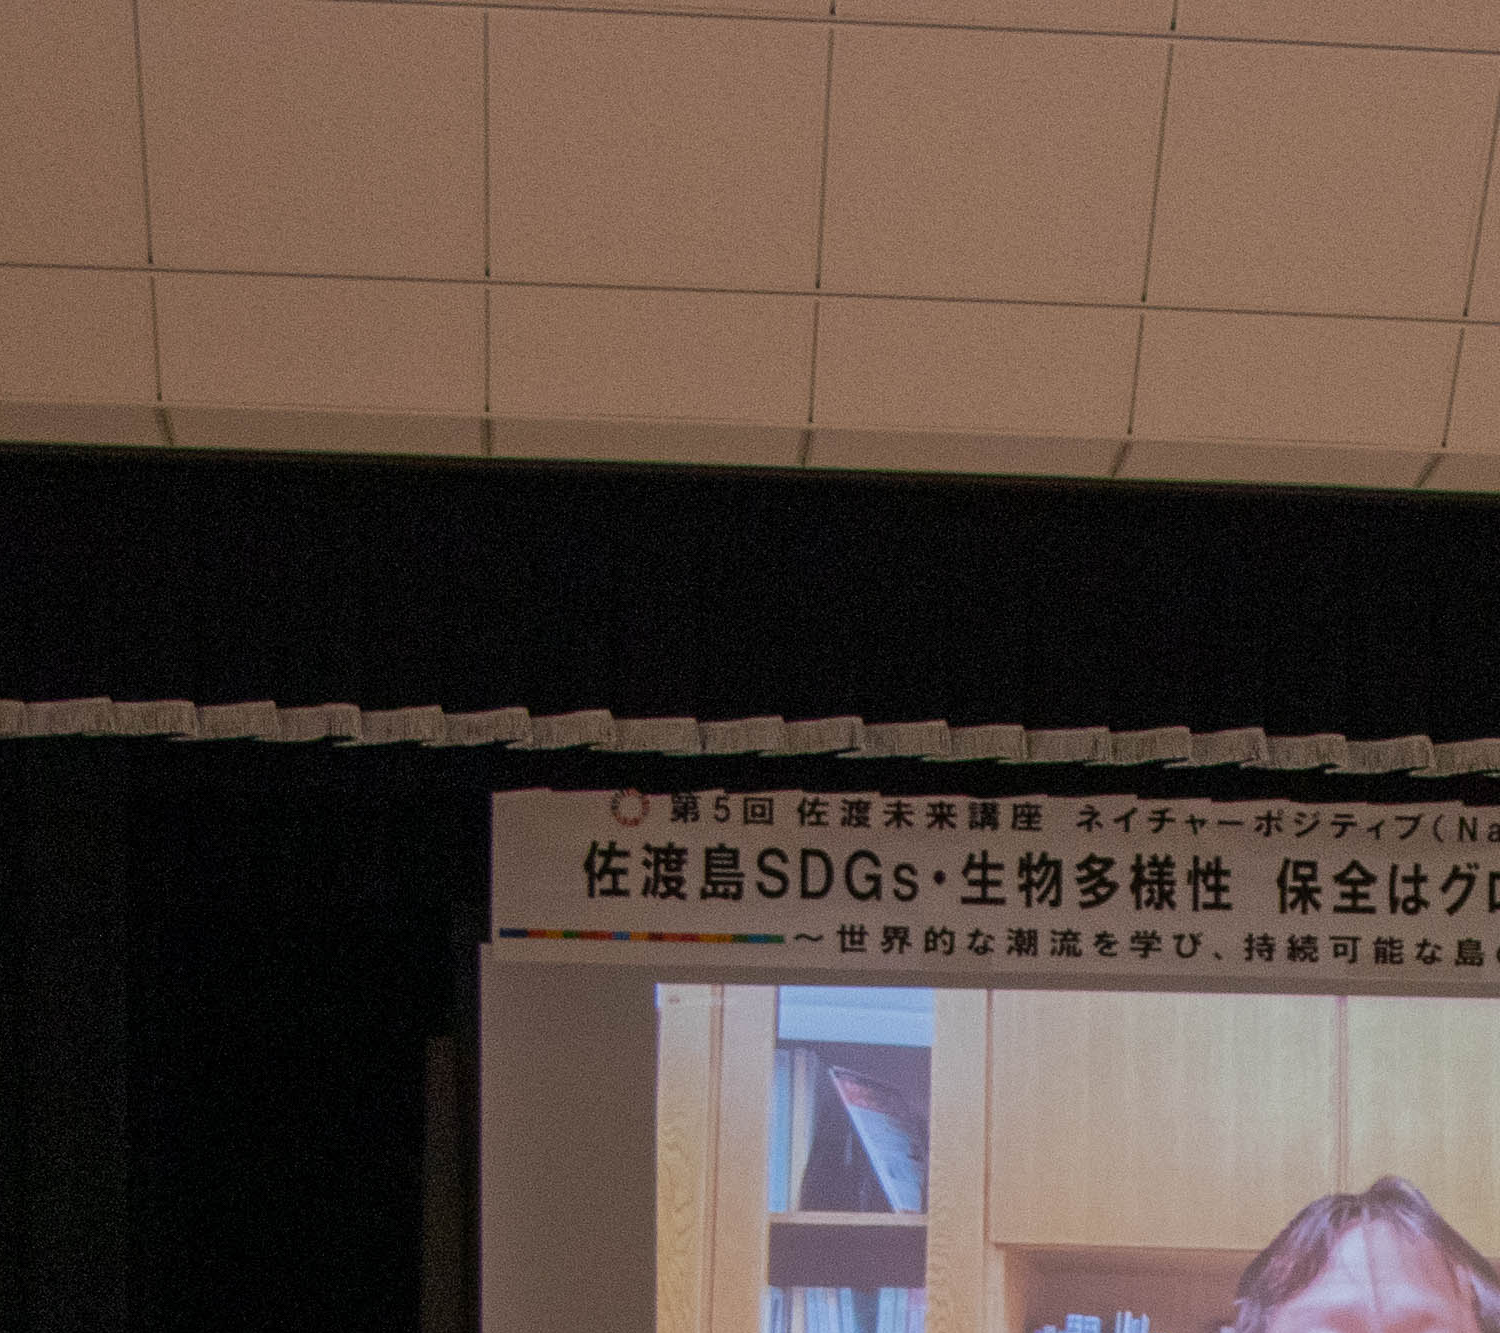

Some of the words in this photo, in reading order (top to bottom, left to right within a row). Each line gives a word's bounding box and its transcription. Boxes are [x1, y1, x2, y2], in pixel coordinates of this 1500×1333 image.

[670, 792, 774, 825] 第5回
[797, 798, 1043, 831] 佐渡未来講座
[583, 840, 1233, 912] 佐渡島SDGs・生物多様性
